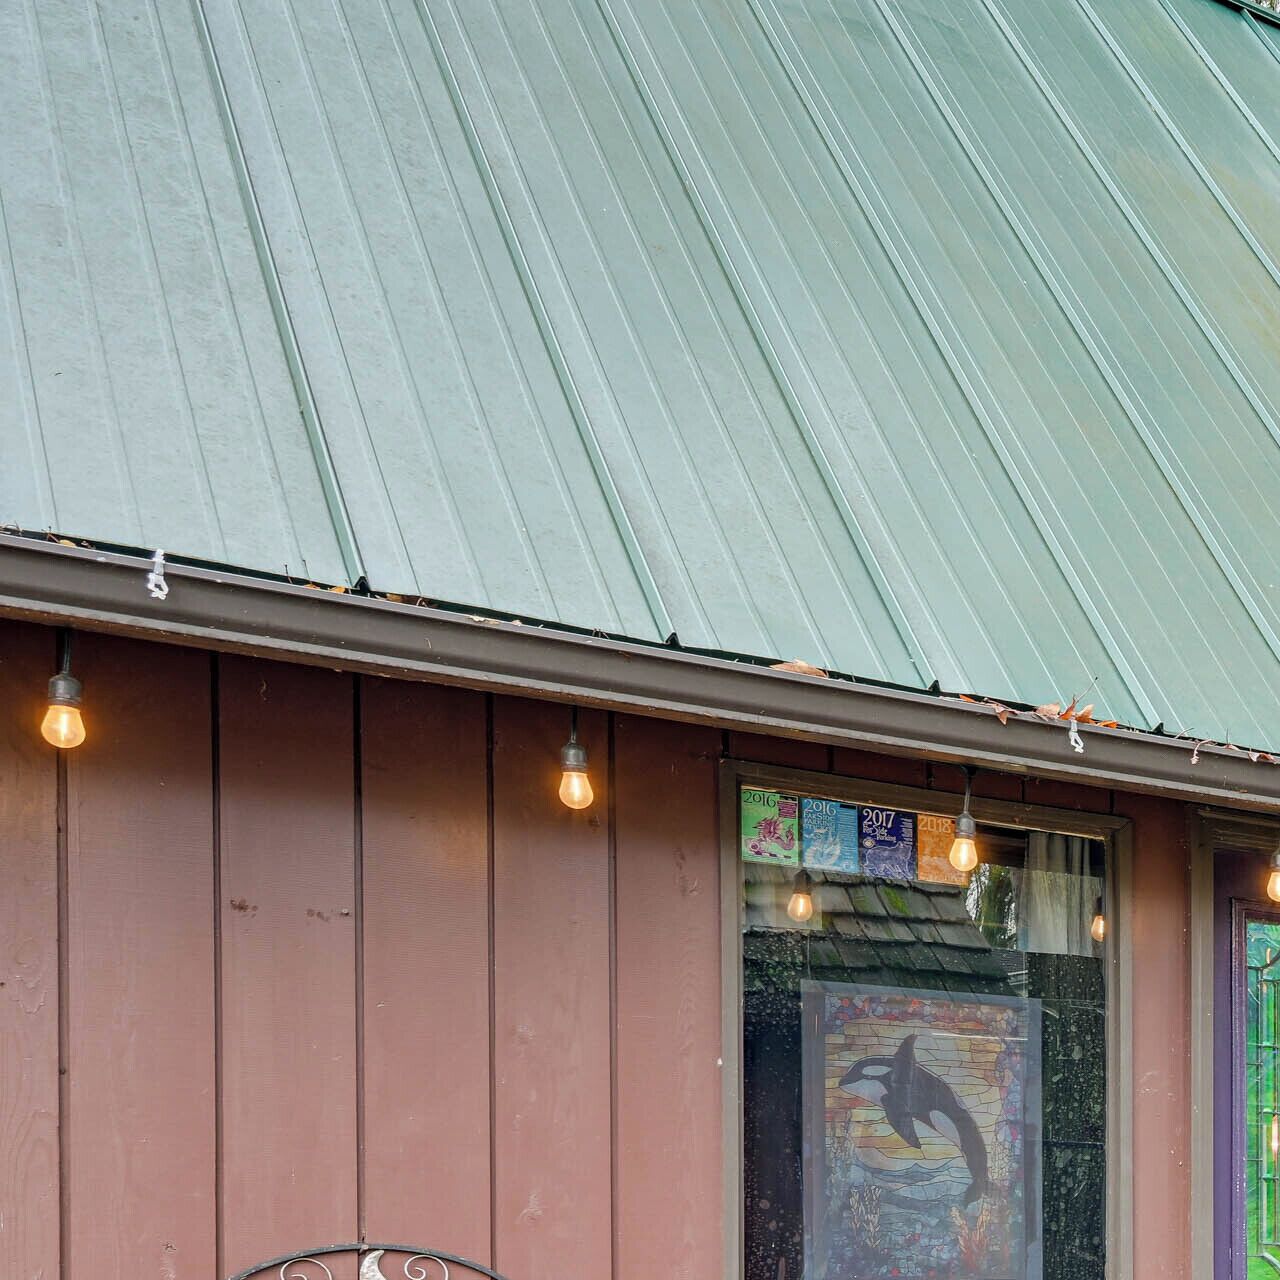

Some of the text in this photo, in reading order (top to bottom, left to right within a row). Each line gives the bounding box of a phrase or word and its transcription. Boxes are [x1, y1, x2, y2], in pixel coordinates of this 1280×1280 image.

[743, 791, 776, 808] 2016
[804, 799, 836, 816] 2016
[863, 808, 896, 828] 2017
[919, 817, 950, 833] 2018
